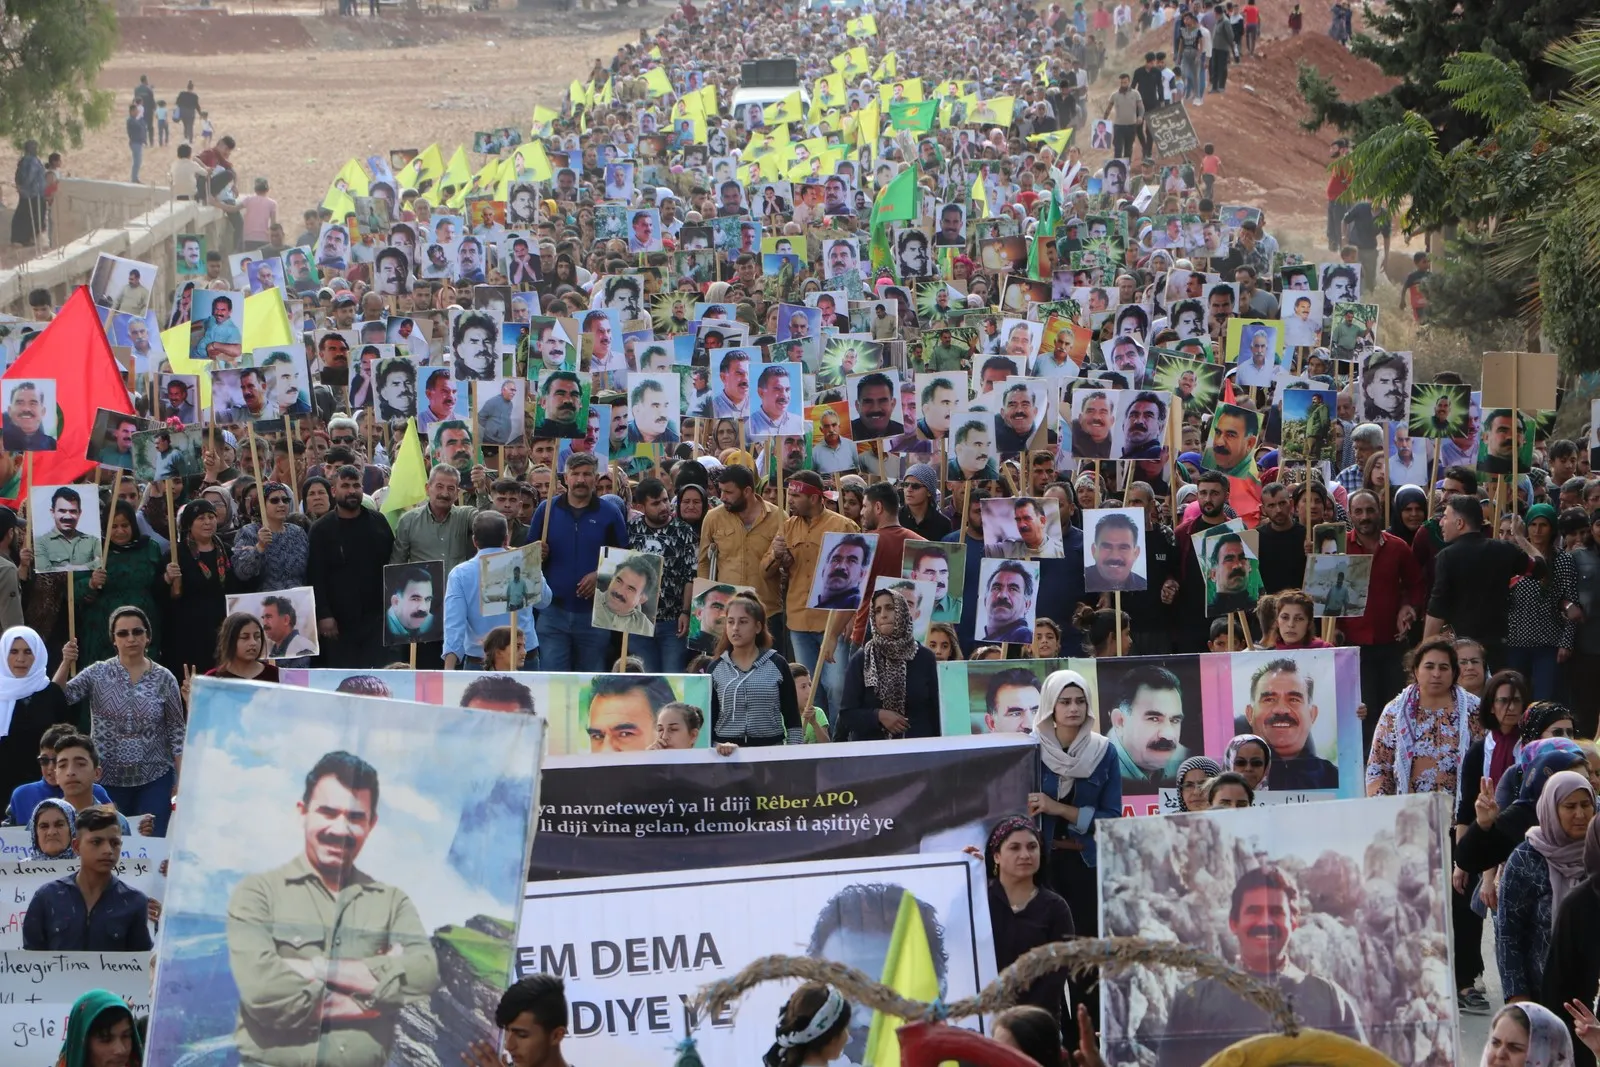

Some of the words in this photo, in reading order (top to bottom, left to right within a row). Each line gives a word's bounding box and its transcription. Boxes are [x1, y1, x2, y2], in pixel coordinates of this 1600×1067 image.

[538, 803, 557, 817] ya
[560, 799, 675, 818] navneteweyî
[678, 802, 699, 817] ya
[703, 797, 715, 812] li
[720, 796, 750, 814] dijî
[756, 795, 810, 810] Rêber
[813, 791, 858, 808] APO,
[540, 818, 553, 833] li
[557, 820, 588, 838] dijî
[591, 821, 631, 834] vîna
[634, 819, 690, 838] gelan,
[694, 816, 792, 833] demokrasî
[796, 814, 807, 832] û
[812, 813, 870, 836] aşitiyê
[874, 818, 894, 836] ye
[13, 862, 56, 875] dema
[133, 863, 149, 876] ye
[14, 886, 26, 903] bi
[100, 954, 143, 972] hemû
[591, 932, 723, 976] DEMA
[12, 1017, 57, 1047] gelê
